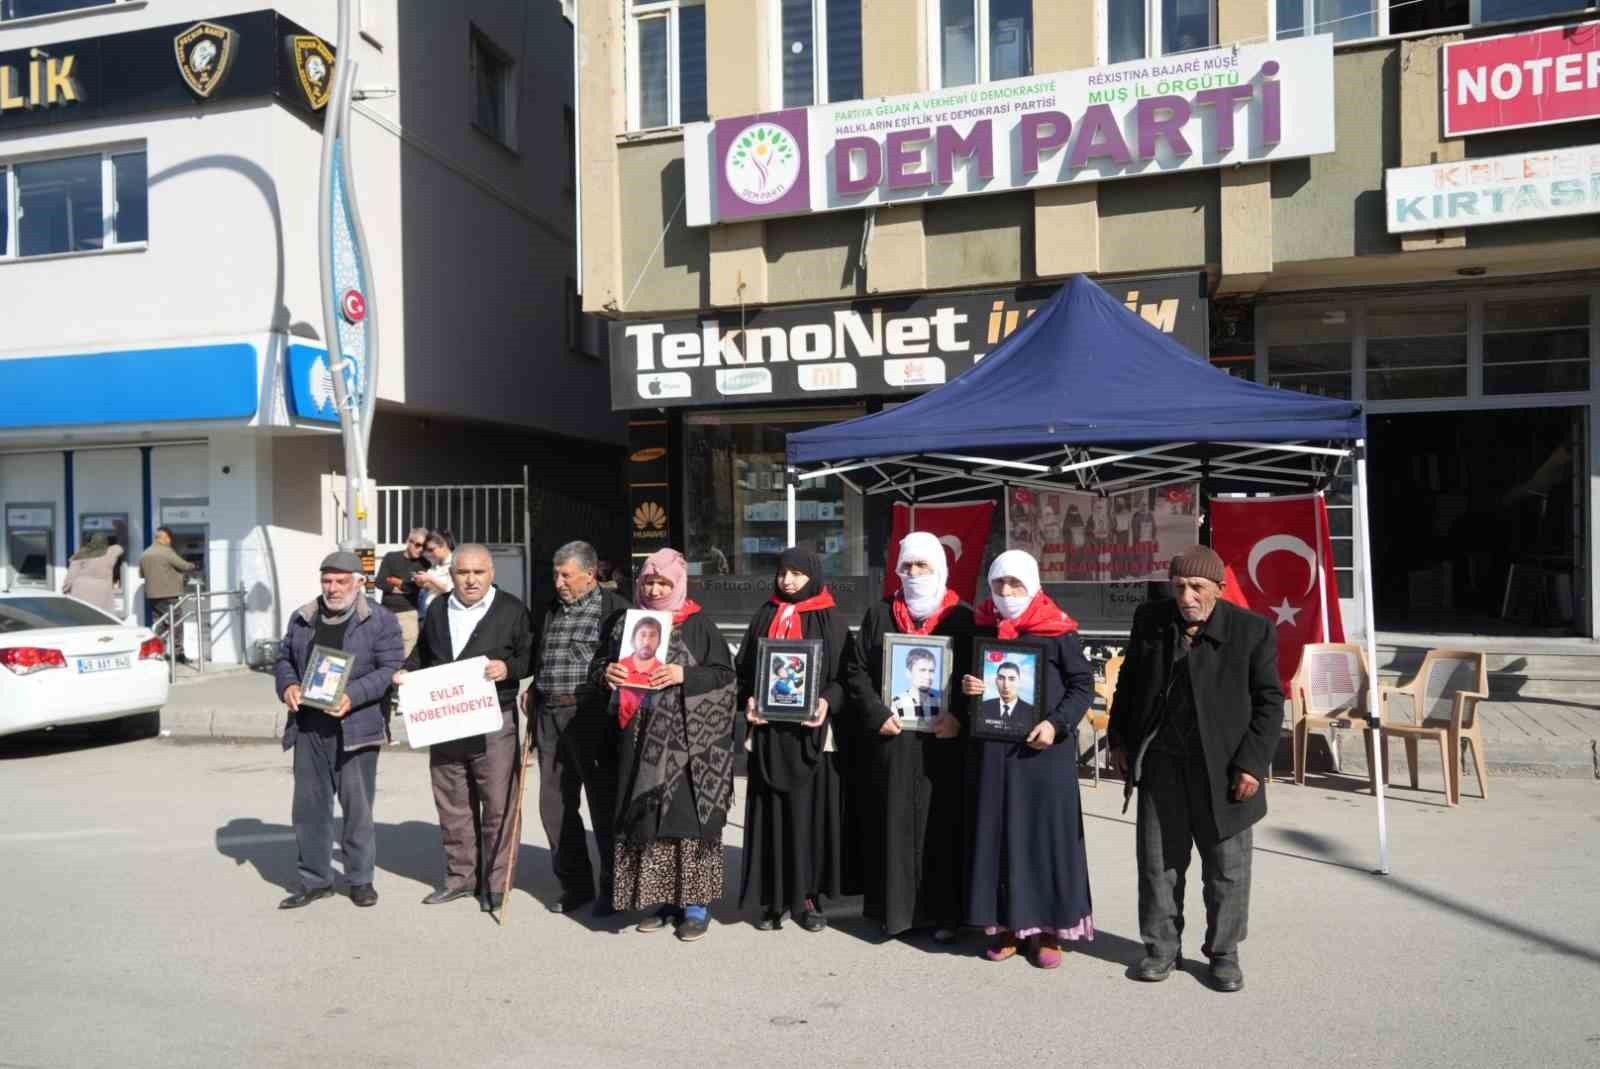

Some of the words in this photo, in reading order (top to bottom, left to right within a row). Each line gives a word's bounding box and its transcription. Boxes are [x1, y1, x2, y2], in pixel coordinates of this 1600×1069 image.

[0, 47, 76, 110] LİK
[1088, 86, 1128, 104] MUŞ
[1135, 81, 1151, 98] İL
[1156, 71, 1240, 95] ÖRGÜTÜ
[835, 119, 994, 194] DEM
[1021, 60, 1280, 175] PARTİ
[836, 120, 893, 134] HALKLARIN
[895, 114, 933, 129] EŞİTLİK
[936, 112, 948, 122] VE
[950, 104, 1011, 121] DEMOKRASİ
[1014, 96, 1056, 112] PARTİSİ
[625, 307, 970, 370] TeknoNet
[409, 696, 495, 725] NÖBETİNDEYİZ
[430, 684, 465, 701] EVLAT
